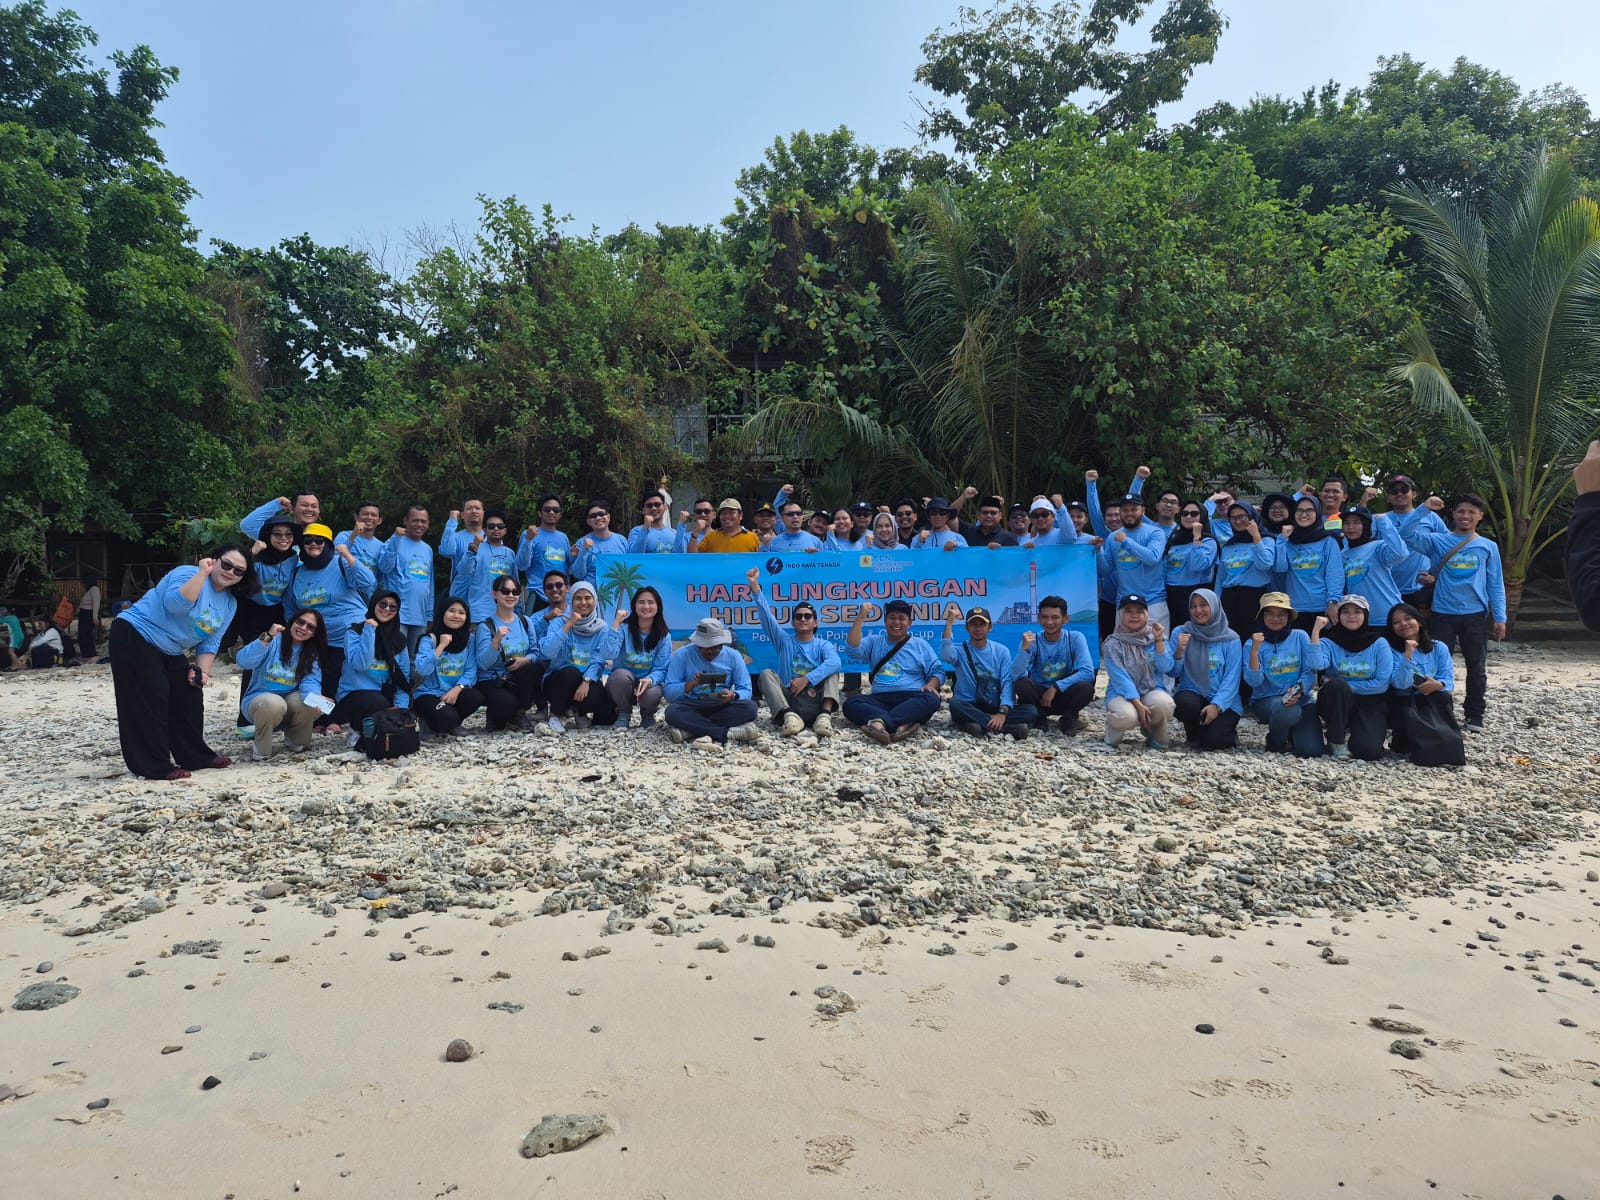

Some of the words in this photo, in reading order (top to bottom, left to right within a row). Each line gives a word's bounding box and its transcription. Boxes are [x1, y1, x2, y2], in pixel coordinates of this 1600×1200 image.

[686, 583, 763, 602] HAR
[771, 578, 987, 601] LINGKUNGAN
[710, 605, 796, 625] HIDU
[820, 602, 964, 624] SEDNIA
